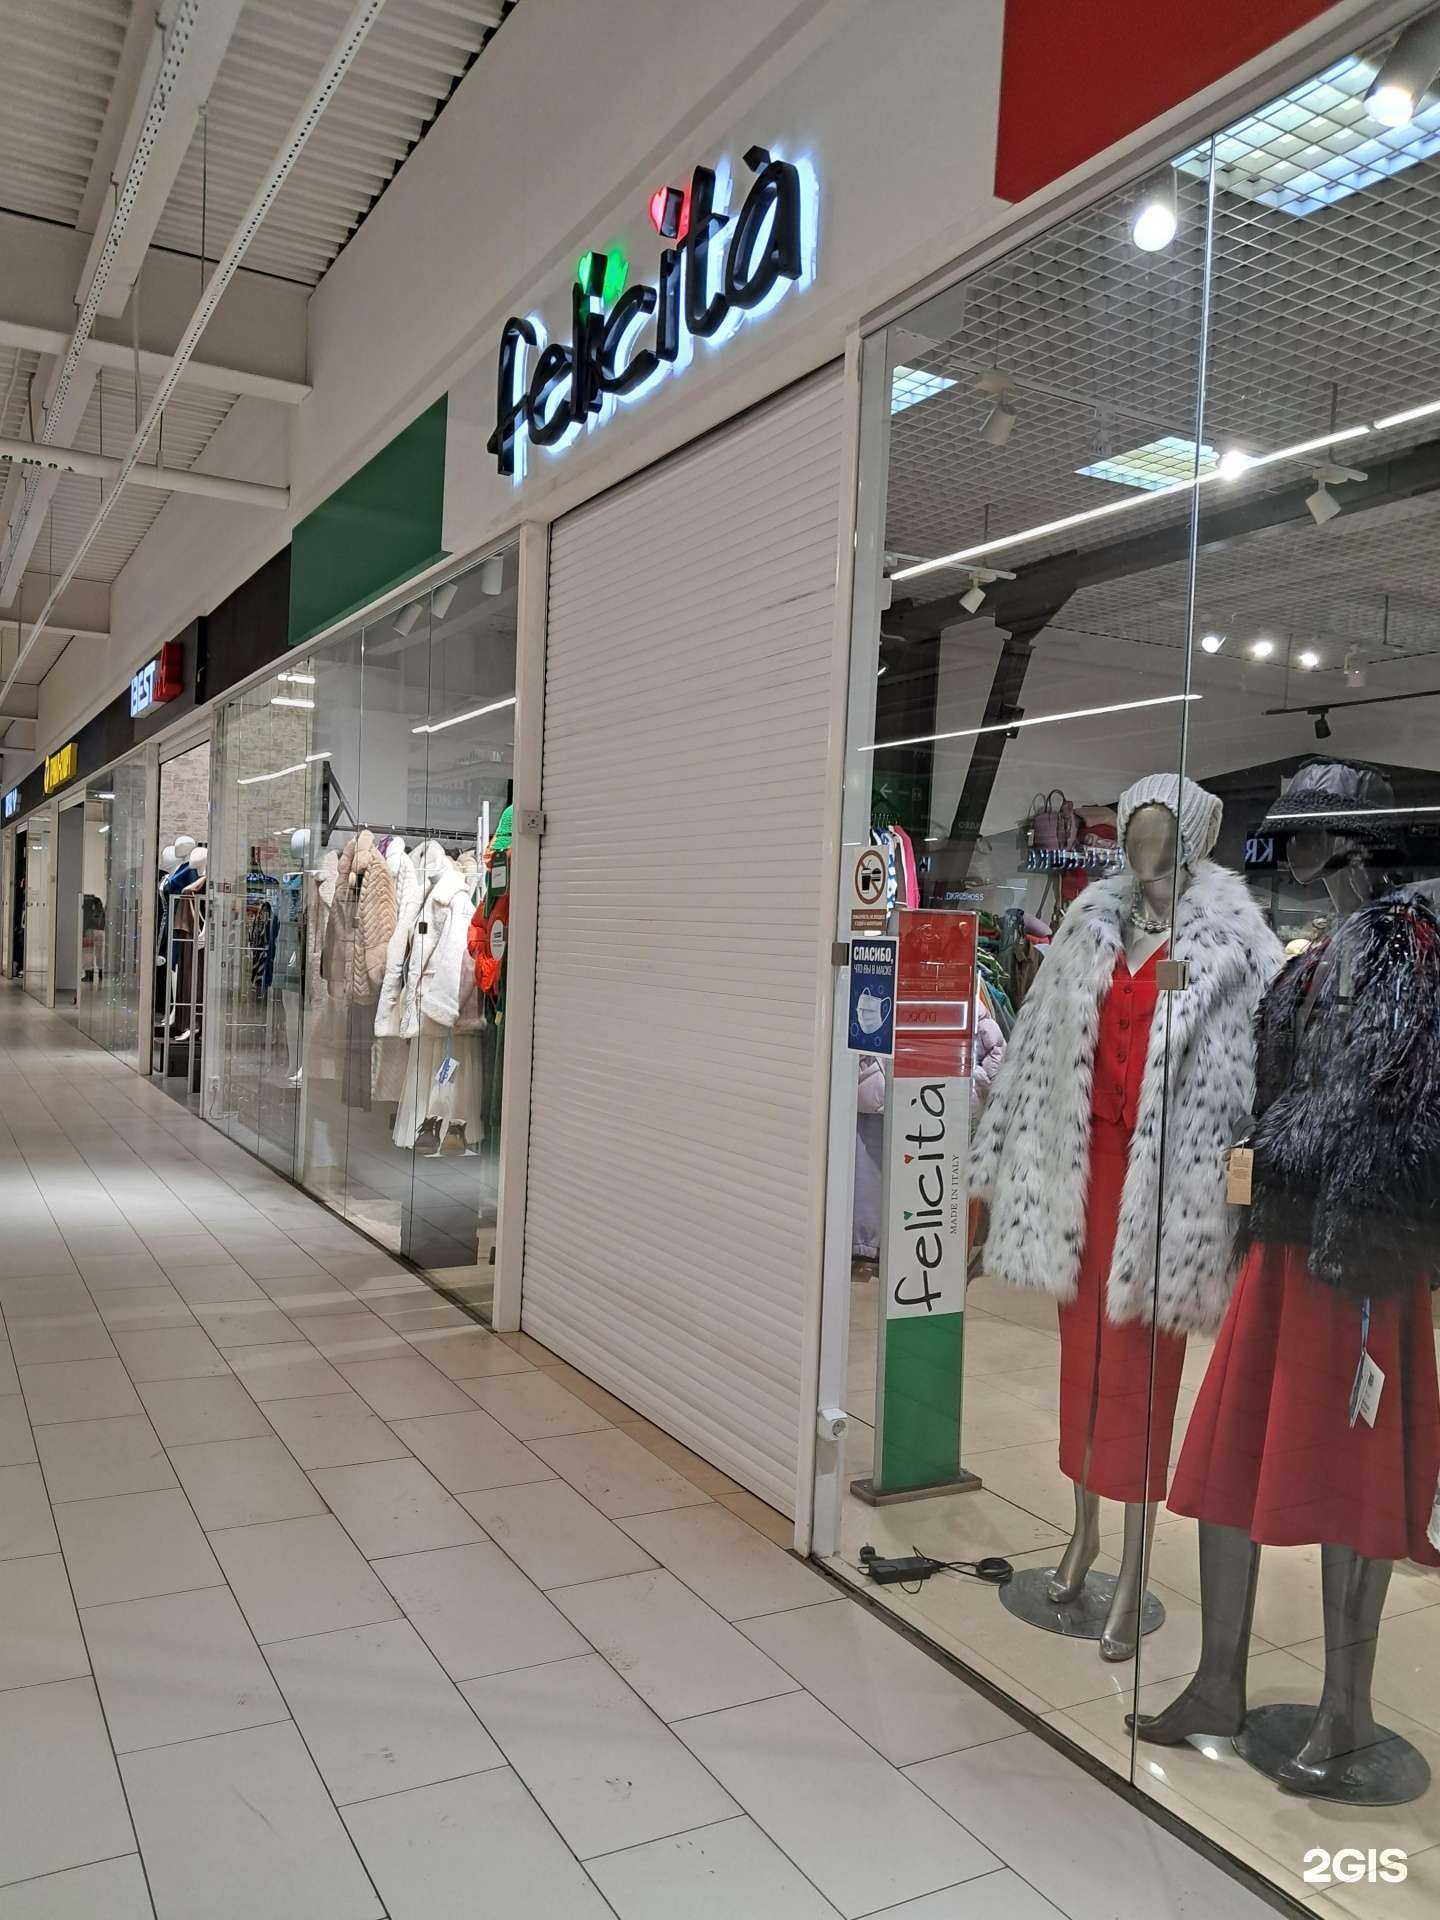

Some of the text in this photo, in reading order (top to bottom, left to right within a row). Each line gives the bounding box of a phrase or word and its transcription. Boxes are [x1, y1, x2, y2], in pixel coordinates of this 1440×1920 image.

[853, 946, 894, 965] СПАСИБО,
[854, 963, 863, 974] ЧТО
[863, 964, 871, 975] ВЫ
[894, 1081, 946, 1313] felicità
[950, 1153, 960, 1235] MADE IN ITALY
